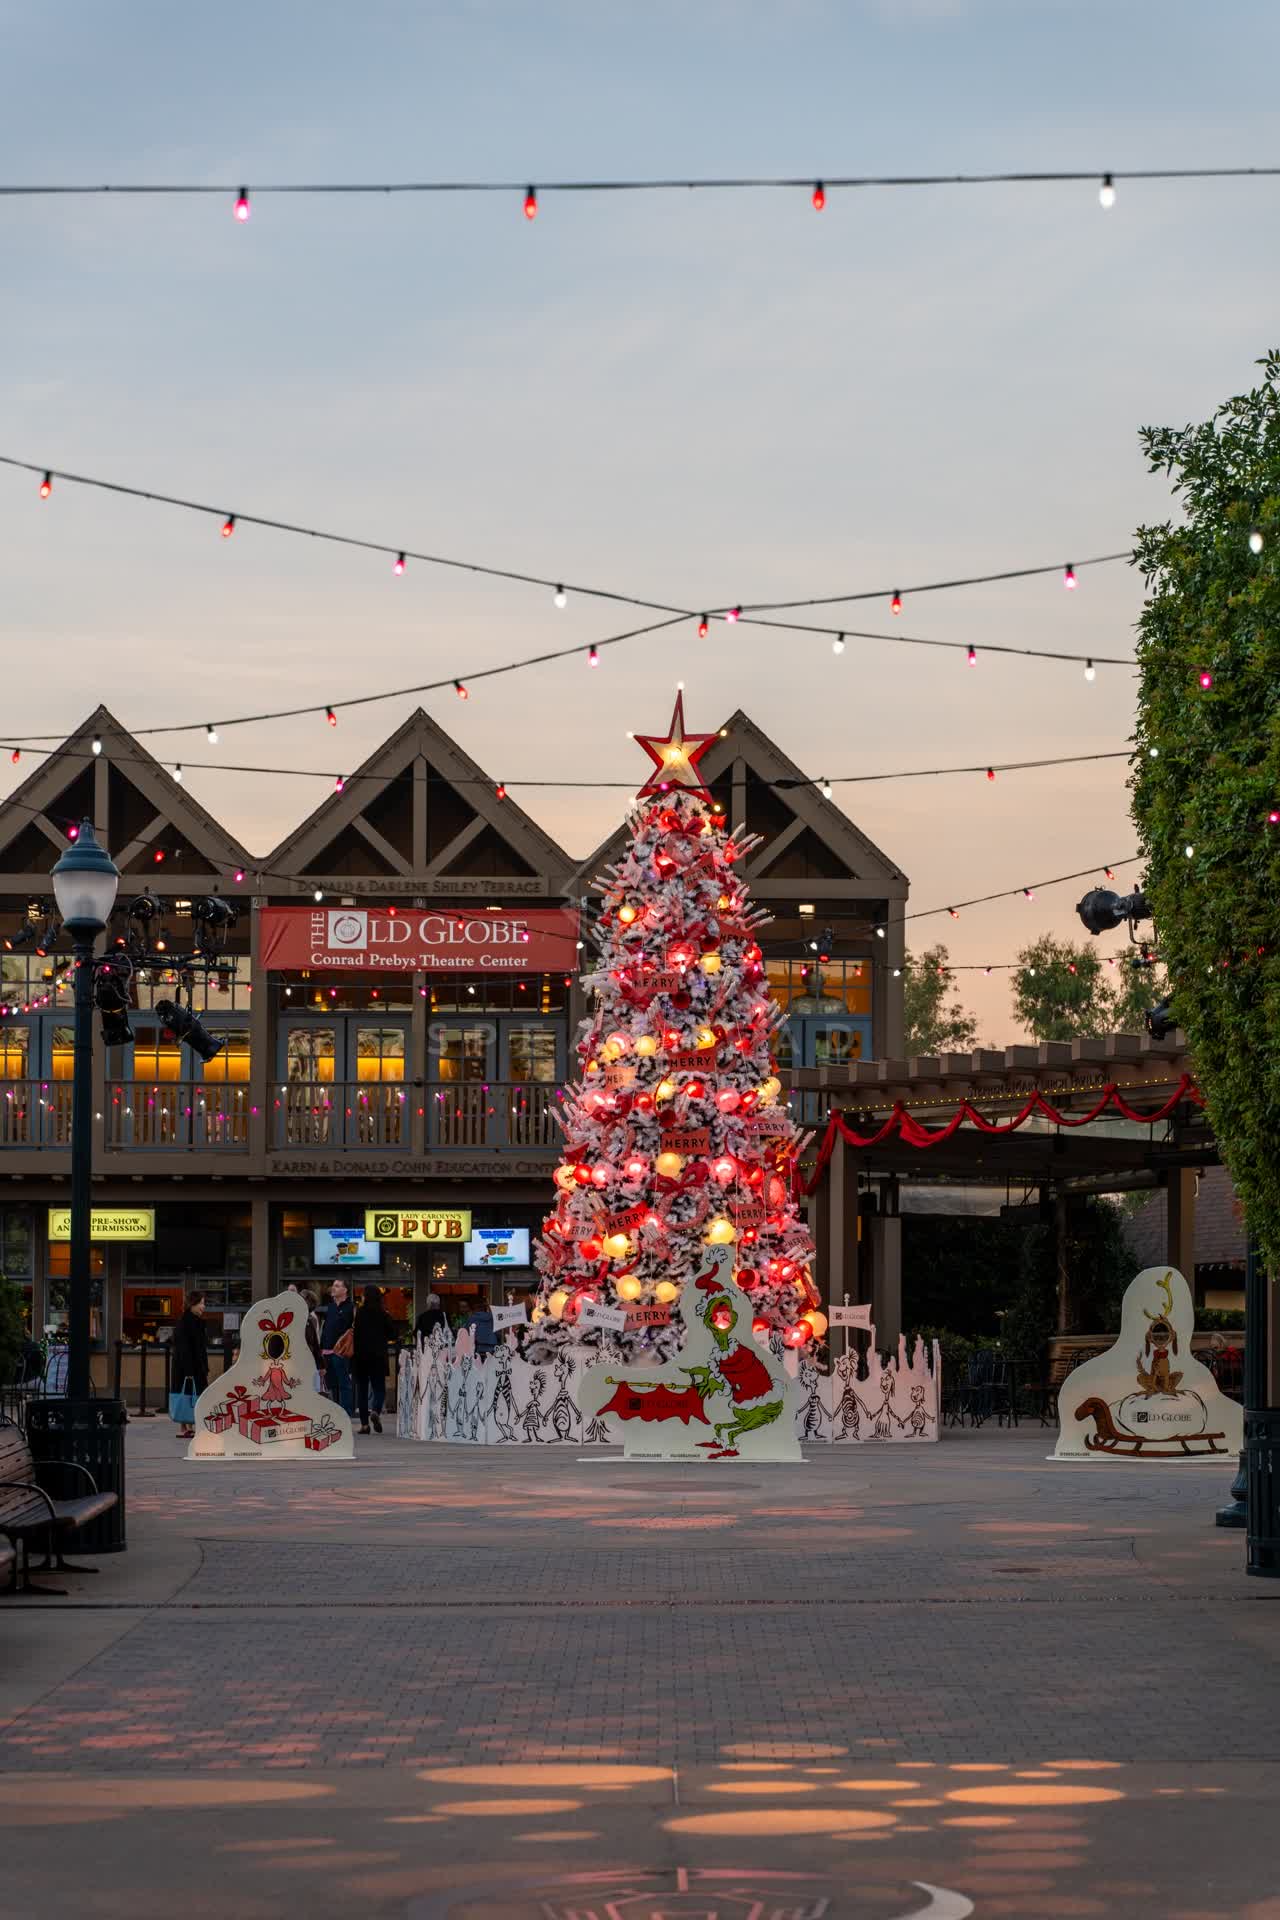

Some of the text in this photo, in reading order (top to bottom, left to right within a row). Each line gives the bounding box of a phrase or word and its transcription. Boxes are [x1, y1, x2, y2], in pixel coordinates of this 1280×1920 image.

[368, 881, 430, 893] DARLENE
[432, 881, 478, 893] SHILEY
[480, 881, 542, 893] TERRACE
[311, 912, 325, 949] THE
[419, 917, 528, 945] GLOBE
[311, 953, 529, 969] Conrad Prebys Theatre Center
[669, 1055, 712, 1068] MERRY
[664, 1138, 706, 1149] MERRY
[272, 1160, 316, 1173] KAREN
[334, 1160, 388, 1173] DONALD
[392, 1160, 431, 1173] COHN
[436, 1160, 512, 1173] EDUCATION
[91, 1217, 141, 1225] PRE-SHOW
[608, 1211, 647, 1230] MERRY
[401, 1219, 463, 1239] PUB
[626, 1311, 667, 1322] MERRY
[1161, 1412, 1193, 1422] GLOBE
